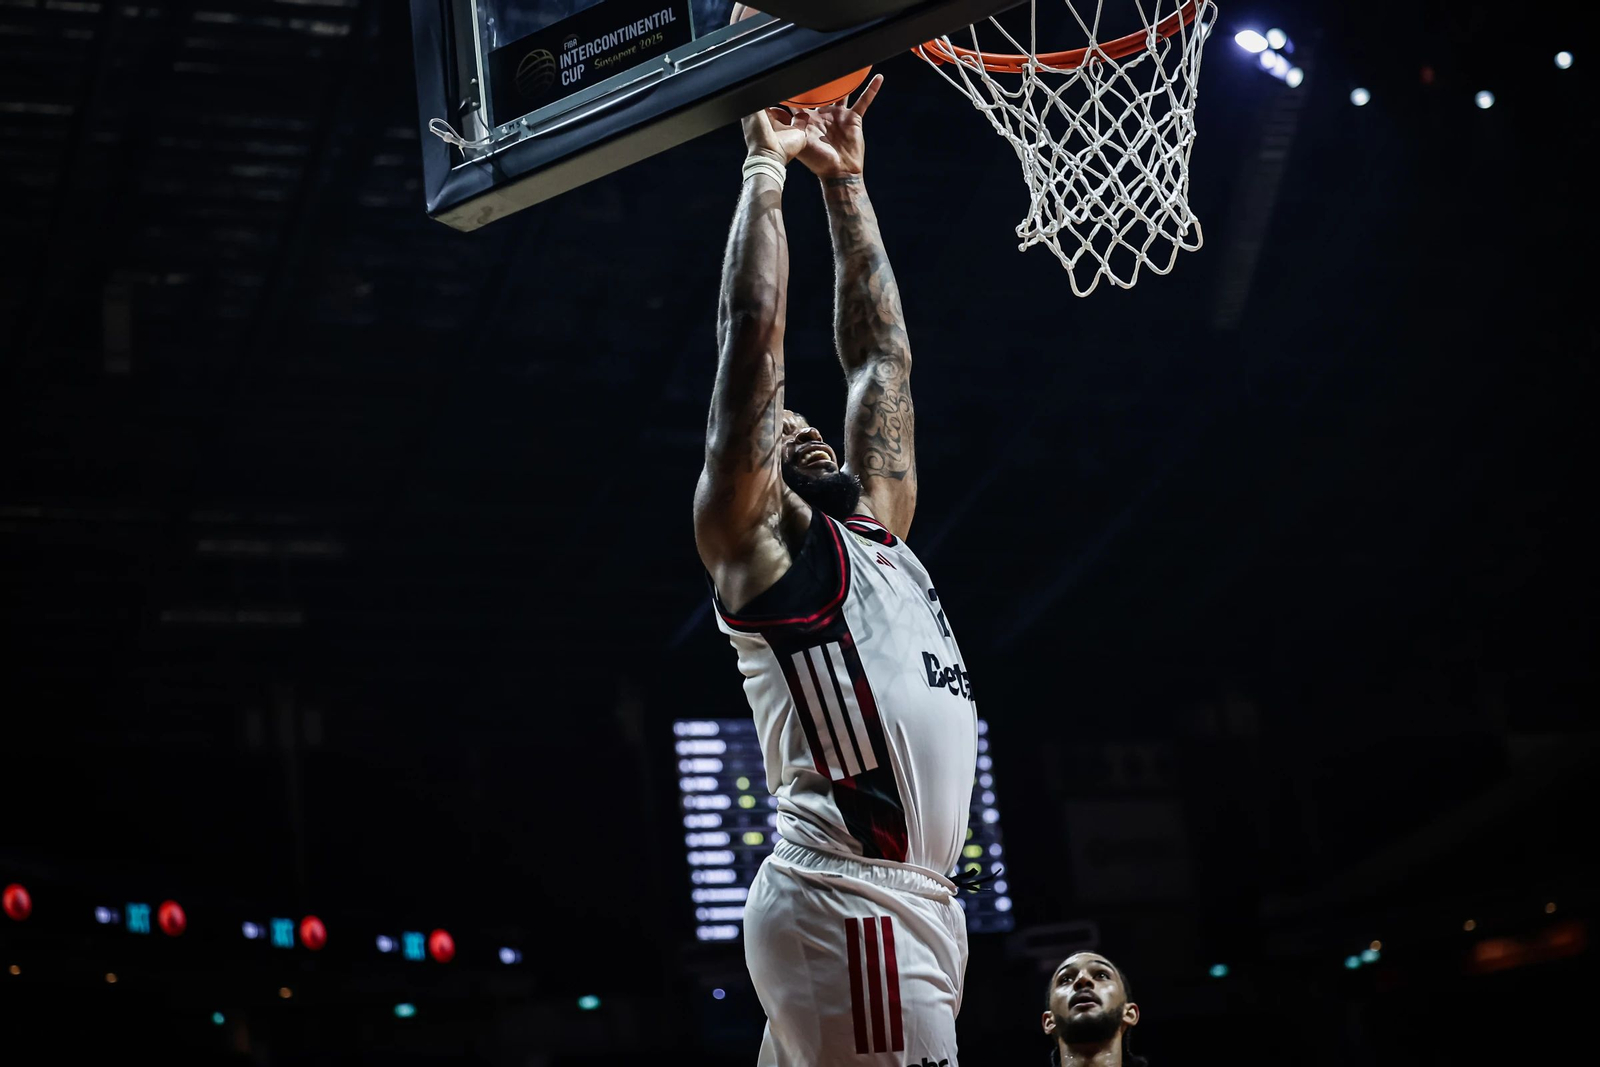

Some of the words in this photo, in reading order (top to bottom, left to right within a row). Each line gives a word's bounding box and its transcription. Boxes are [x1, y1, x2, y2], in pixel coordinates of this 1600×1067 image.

[559, 7, 677, 69] INTERCONTINENTAL
[563, 38, 578, 51] FIBA
[594, 44, 637, 70] Singapore
[639, 32, 664, 50] 2025
[561, 63, 585, 86] CUP
